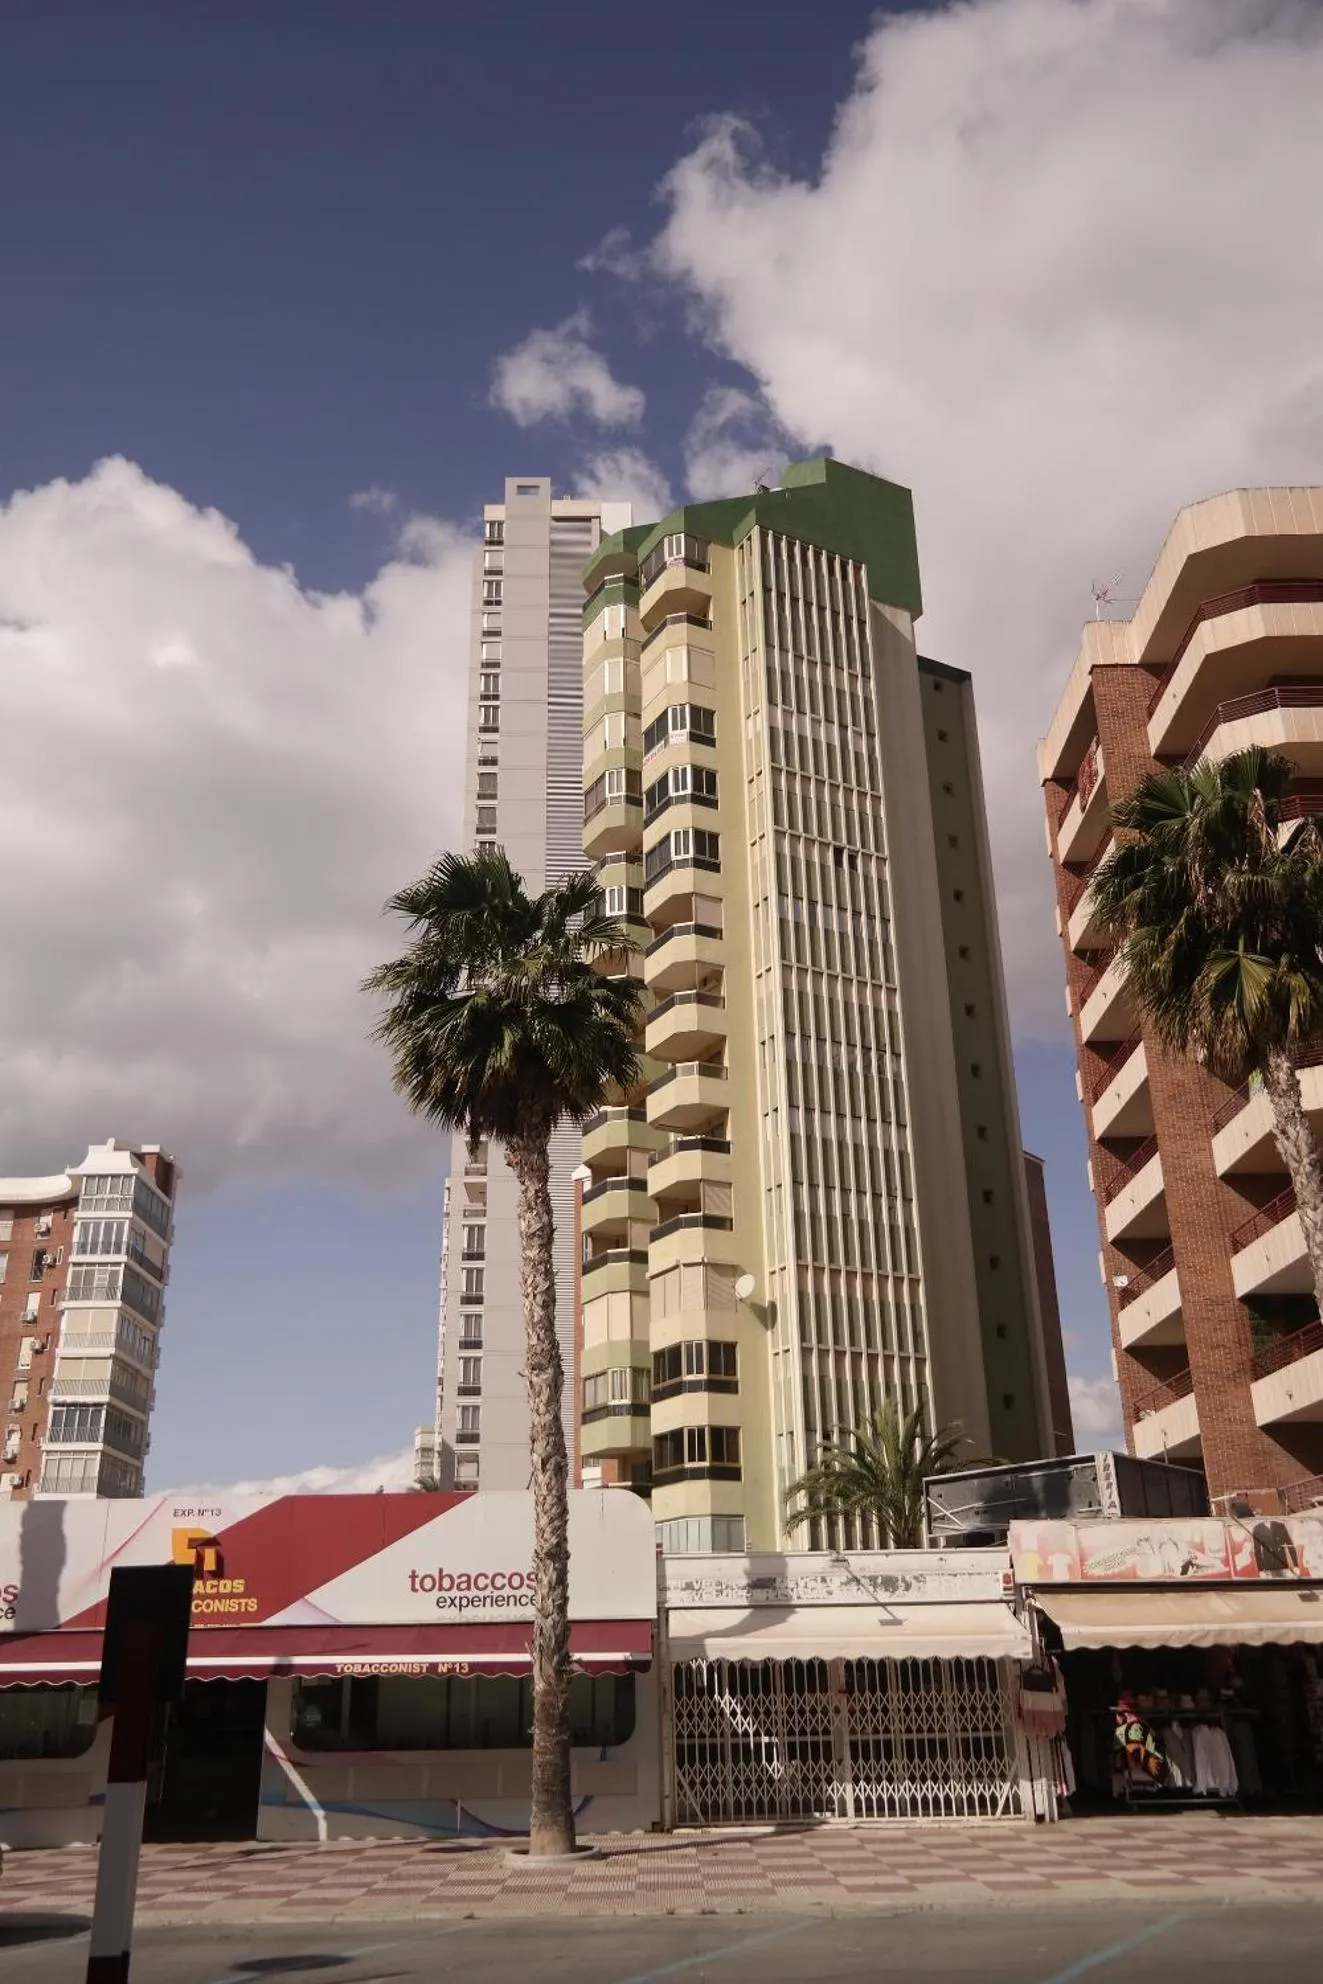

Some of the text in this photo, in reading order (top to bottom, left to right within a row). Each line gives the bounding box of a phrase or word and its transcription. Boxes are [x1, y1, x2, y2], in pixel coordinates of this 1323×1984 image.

[173, 1508, 196, 1517] EXP.
[192, 1579, 245, 1594] ACOS
[408, 1567, 538, 1592] tobaccos
[191, 1598, 258, 1613] CONISTS
[335, 1663, 429, 1673] TOBACCONIST
